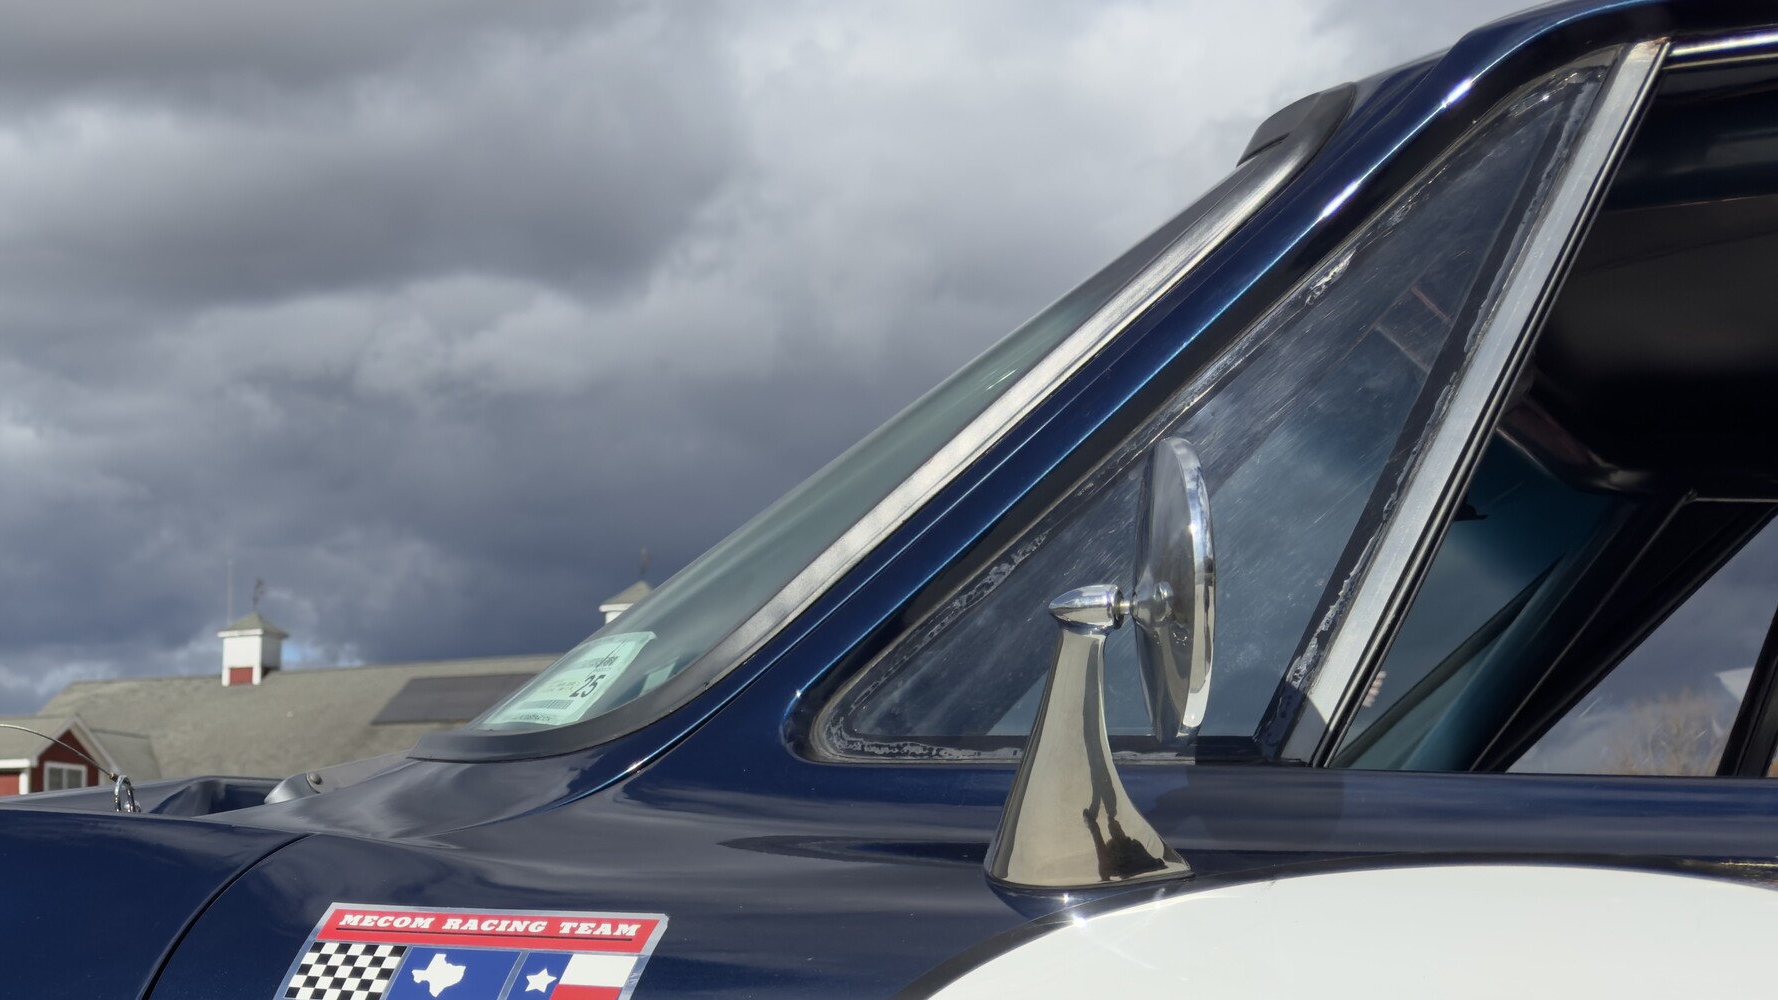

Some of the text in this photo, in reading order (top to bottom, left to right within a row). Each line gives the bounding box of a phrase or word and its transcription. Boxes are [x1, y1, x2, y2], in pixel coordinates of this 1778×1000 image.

[569, 674, 606, 699] 25
[338, 913, 643, 938] MECOM RACING TEAM
